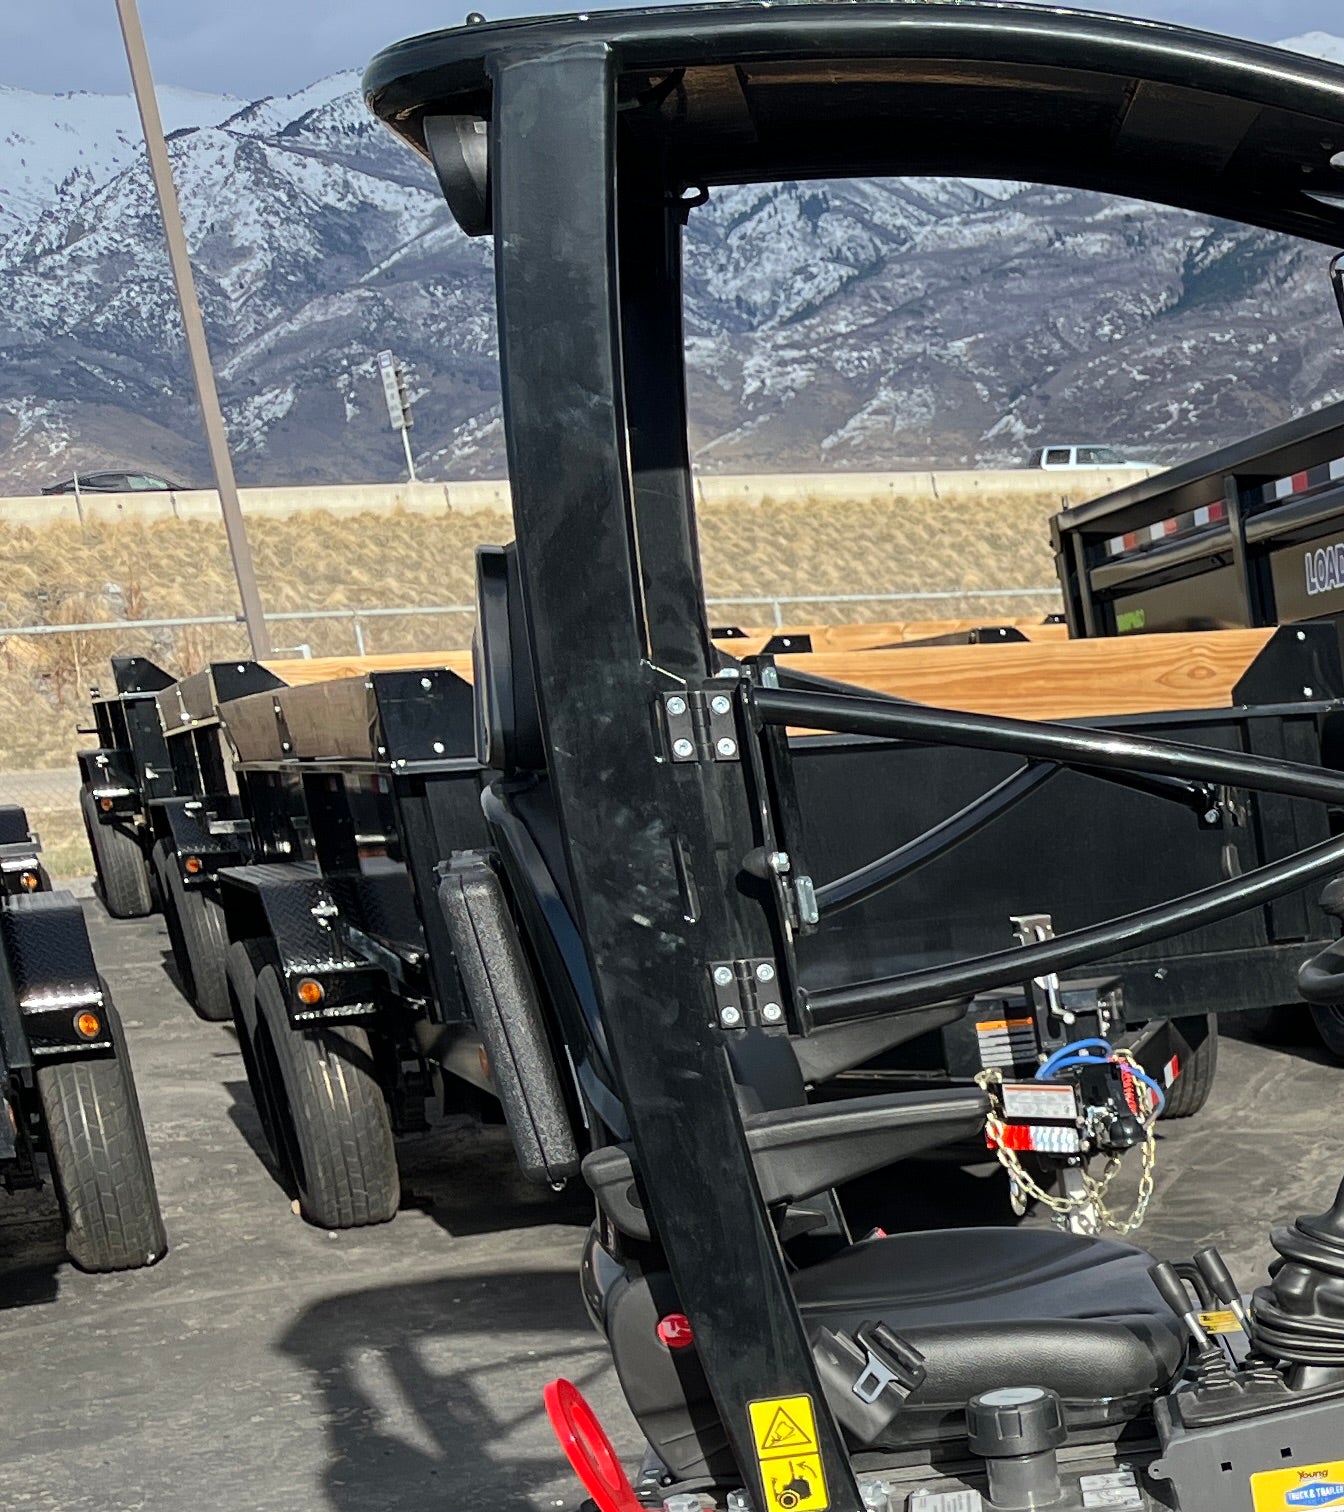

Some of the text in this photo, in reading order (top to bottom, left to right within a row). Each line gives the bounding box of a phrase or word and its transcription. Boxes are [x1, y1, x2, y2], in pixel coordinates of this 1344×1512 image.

[1296, 1470, 1329, 1480] Young
[1287, 1488, 1310, 1501] TRUCK
[1316, 1485, 1344, 1498] TRAILER
